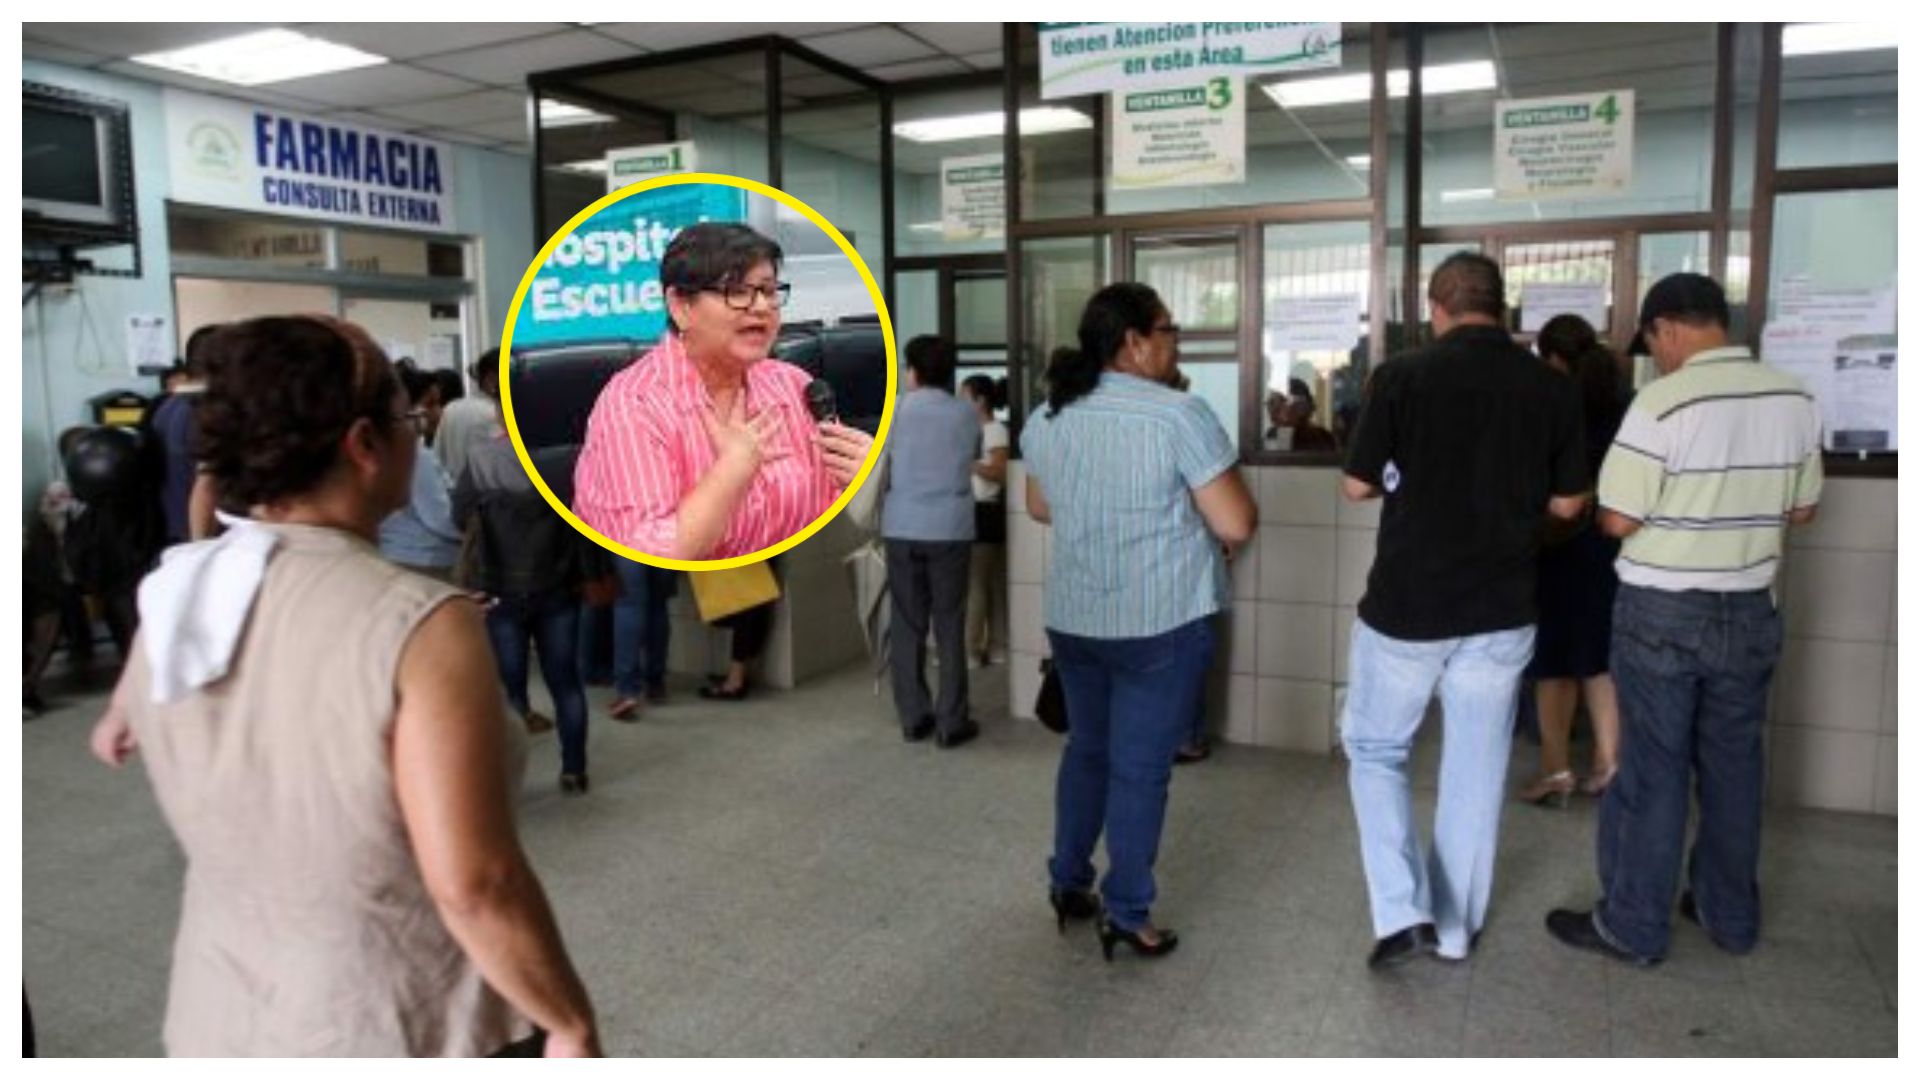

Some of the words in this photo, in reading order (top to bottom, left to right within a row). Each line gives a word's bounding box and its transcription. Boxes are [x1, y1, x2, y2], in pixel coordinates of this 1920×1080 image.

[1050, 34, 1107, 56] tienen
[1124, 57, 1146, 75] en
[1151, 49, 1194, 71] esta
[1208, 76, 1233, 110] 3
[1593, 94, 1621, 126] 4
[253, 112, 443, 195] FARMACIA
[671, 147, 684, 170] 1
[262, 176, 362, 216] CONSULTA
[367, 191, 441, 226] EXTERNA
[544, 214, 710, 275] ospit
